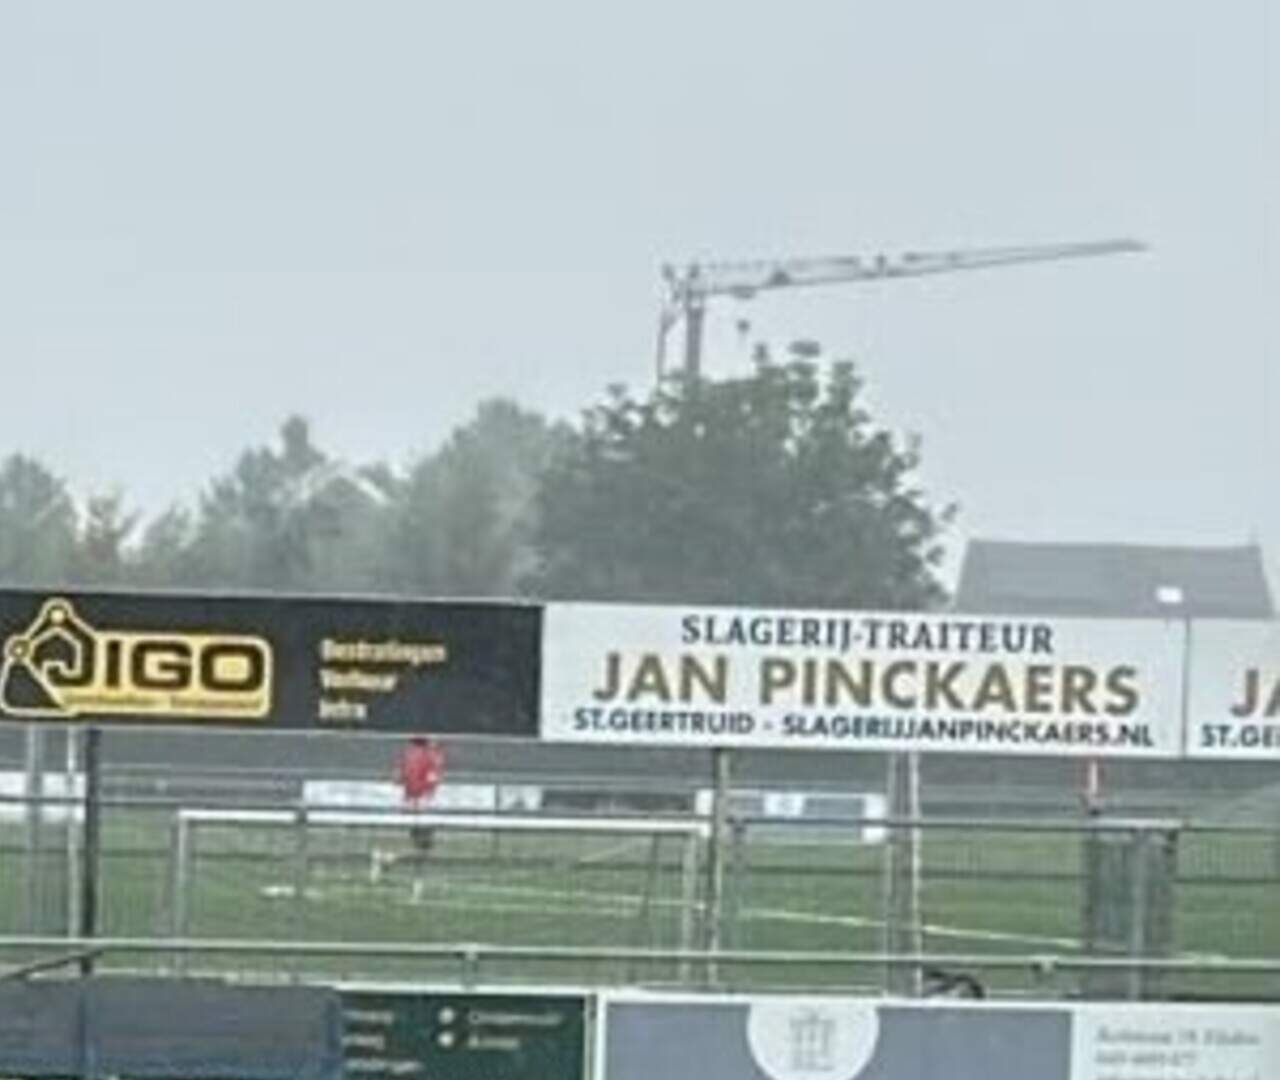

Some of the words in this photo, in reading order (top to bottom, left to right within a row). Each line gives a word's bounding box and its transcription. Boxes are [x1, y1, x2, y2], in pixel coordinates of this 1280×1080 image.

[681, 614, 1055, 655] SLAGERIJ-TRAITEUR
[592, 651, 728, 703] JAN
[760, 656, 1141, 717] PINCKAERS
[1200, 723, 1280, 750] ST.GE
